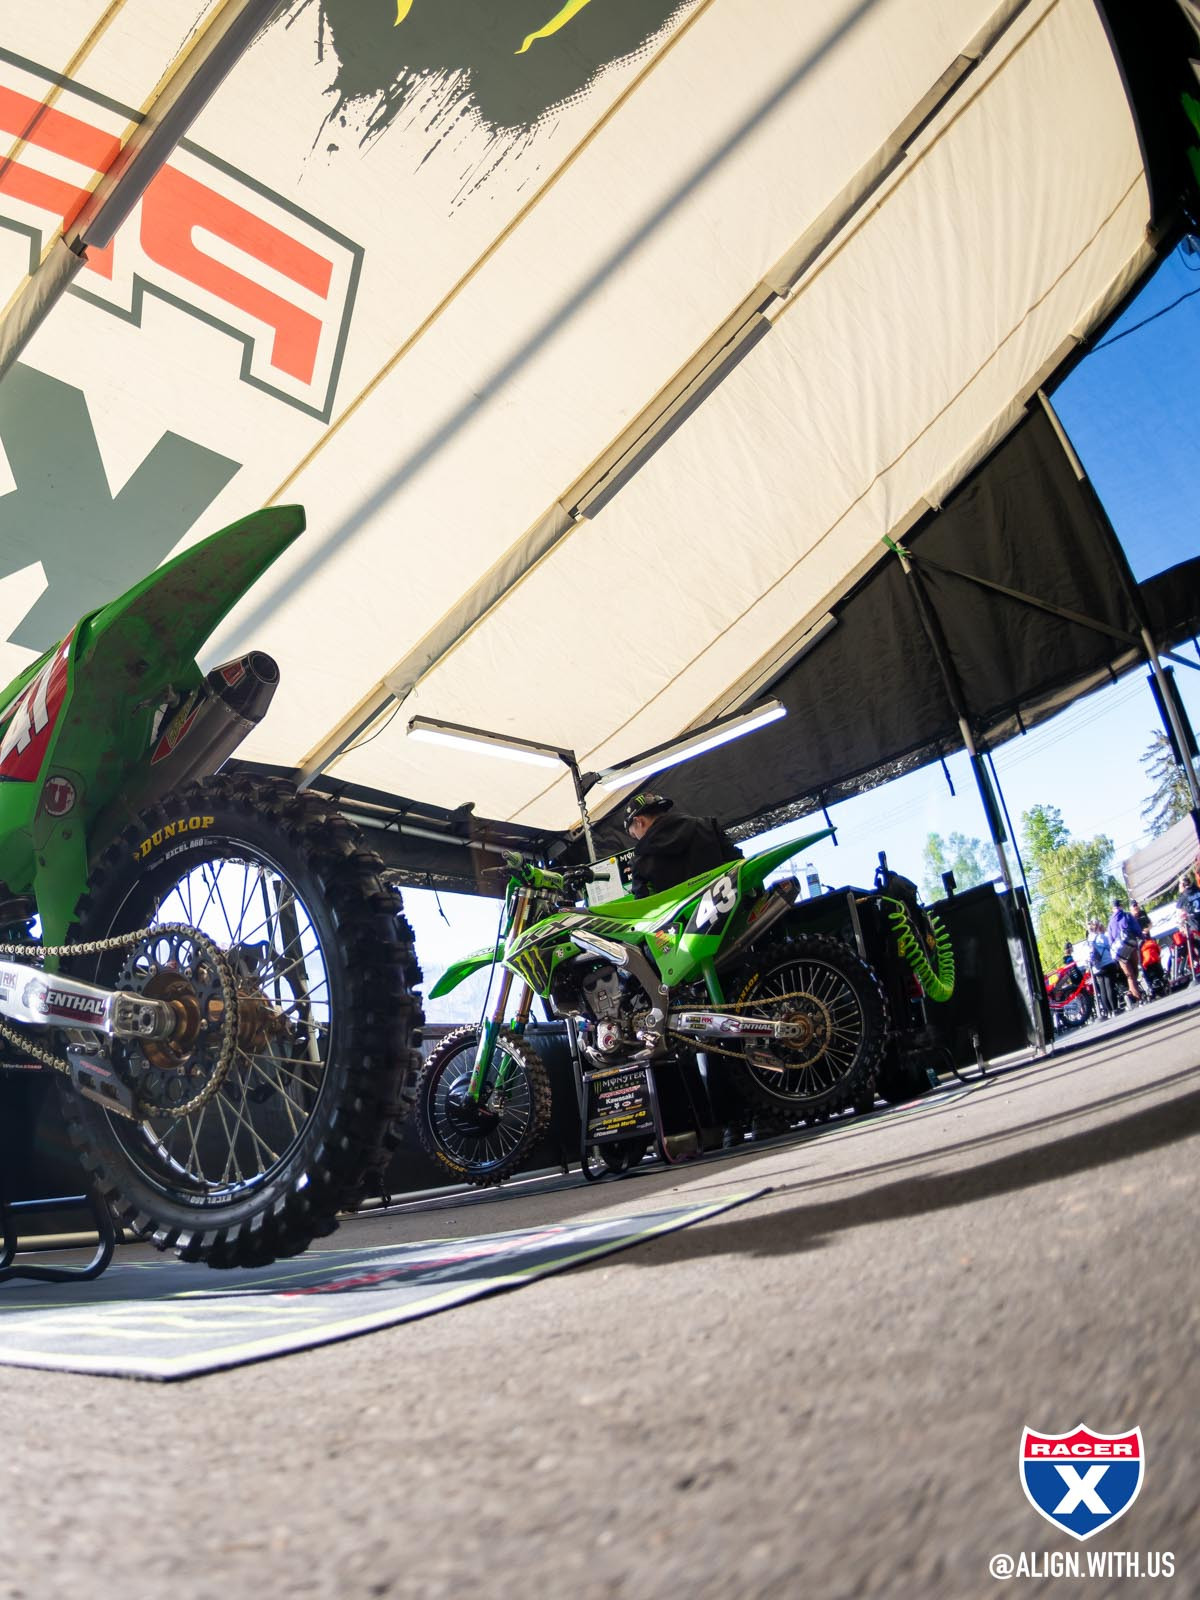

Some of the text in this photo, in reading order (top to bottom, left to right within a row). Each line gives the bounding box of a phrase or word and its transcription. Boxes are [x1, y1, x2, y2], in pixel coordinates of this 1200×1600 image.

[139, 816, 215, 858] DUNLOP
[165, 842, 189, 861] EXCEL
[696, 875, 737, 929] 43
[3, 972, 17, 987] RK
[702, 1016, 713, 1024] RK
[602, 1071, 646, 1087] MONSTER
[605, 1093, 635, 1105] Kawasaki
[207, 1193, 233, 1204] EXCEL
